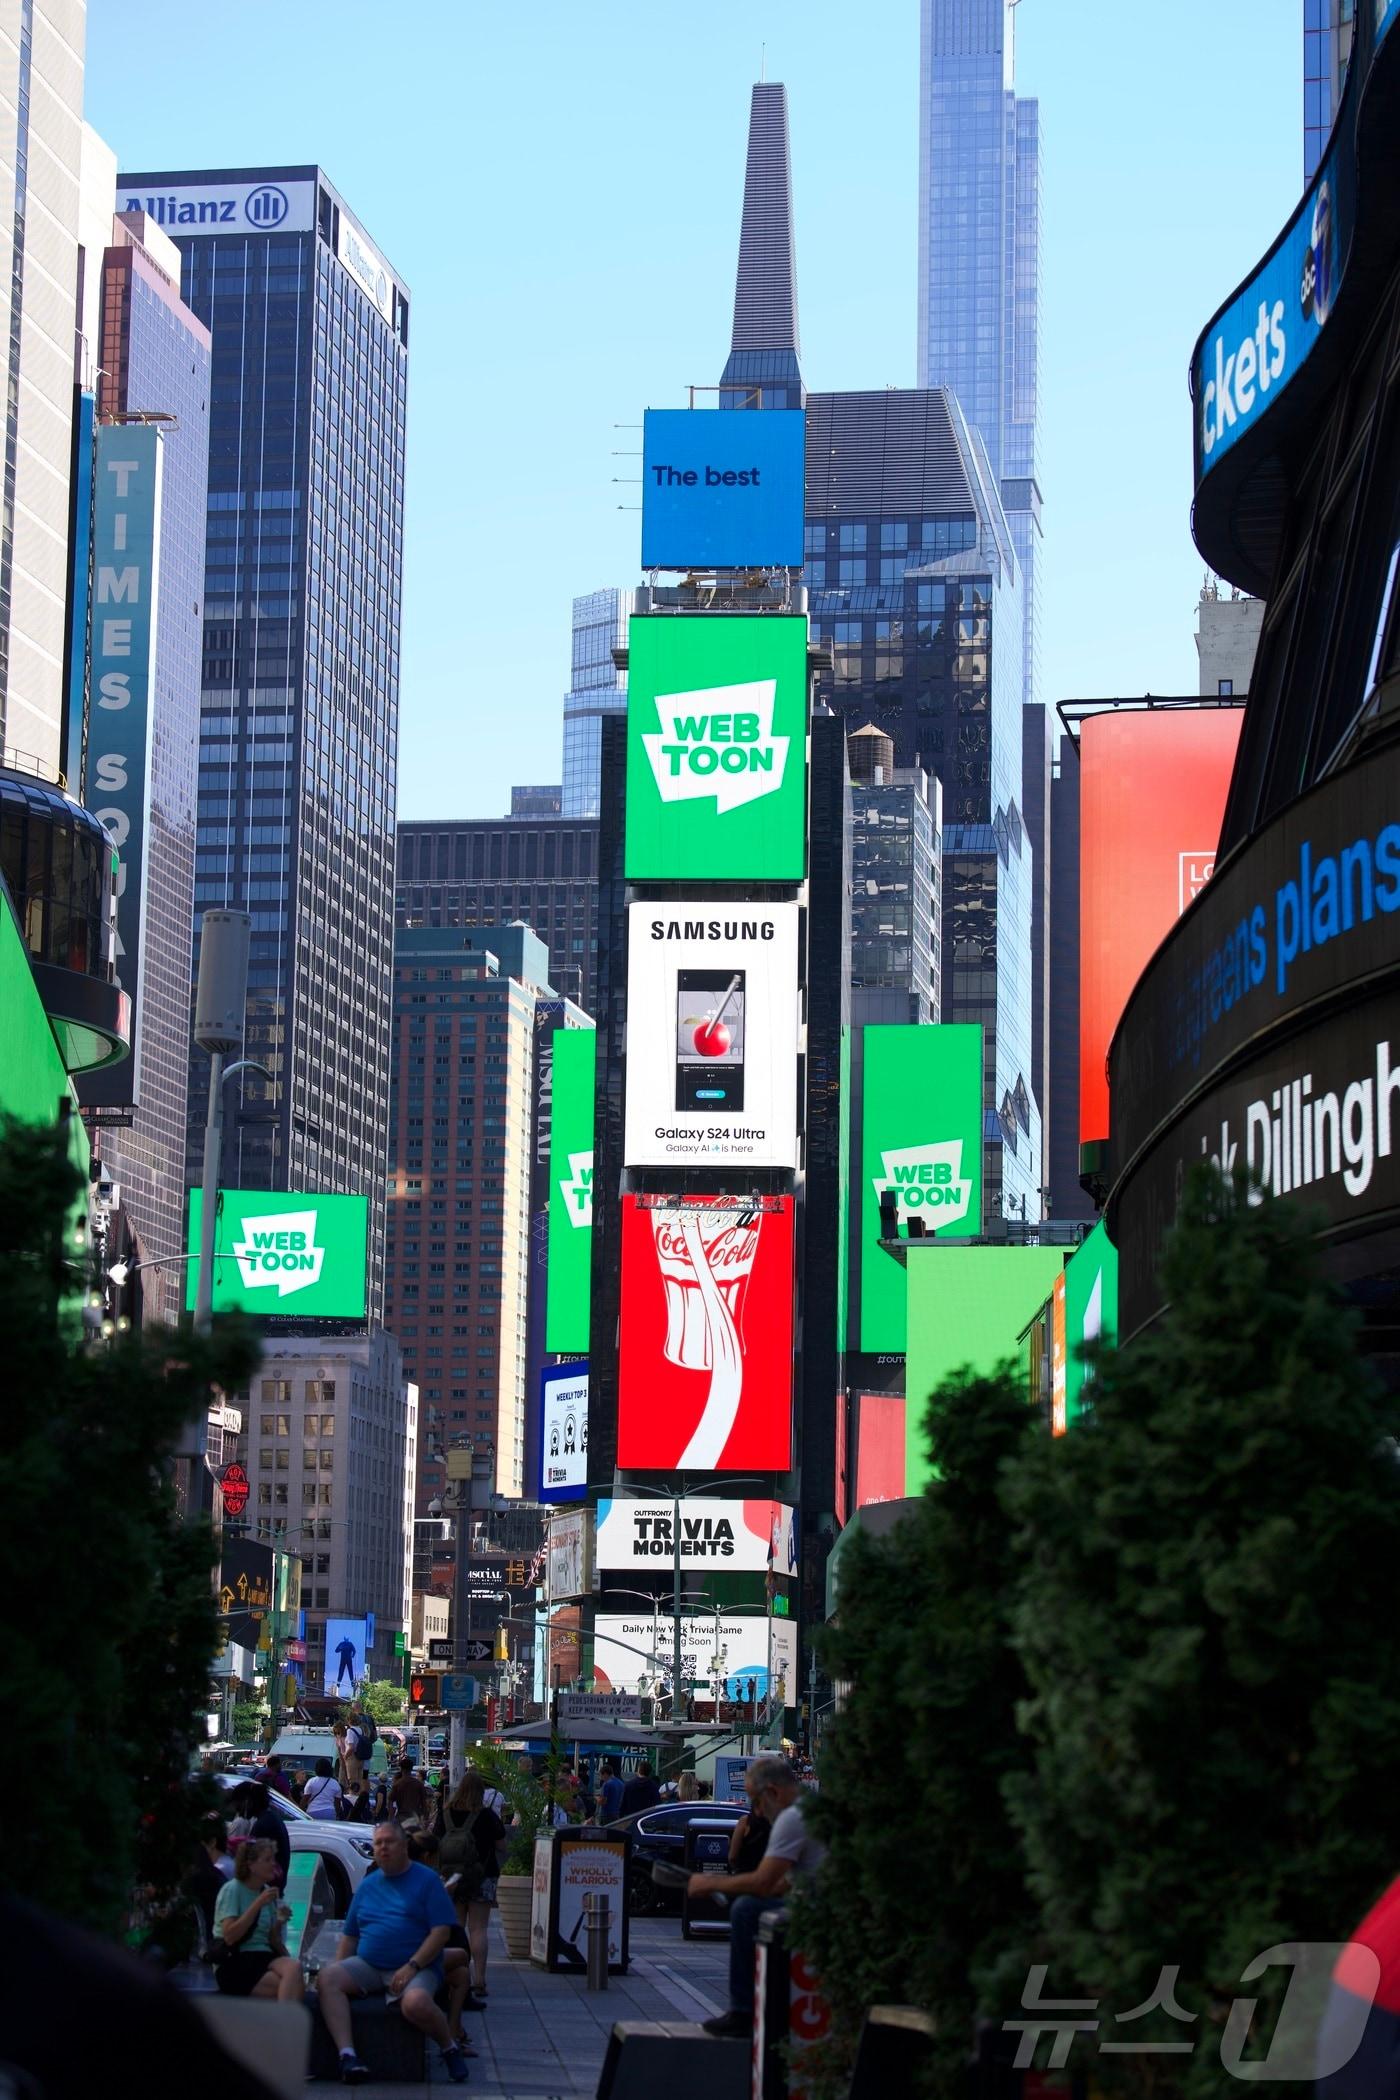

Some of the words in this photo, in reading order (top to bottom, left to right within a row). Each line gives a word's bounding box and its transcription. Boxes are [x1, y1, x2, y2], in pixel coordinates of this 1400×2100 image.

[652, 466, 699, 488] The
[704, 465, 761, 488] best
[96, 460, 140, 711] TIMES
[672, 713, 761, 743] WEB
[661, 745, 774, 777] TOON
[1276, 822, 1400, 997] plans
[651, 920, 776, 942] SAMSUNG
[654, 1127, 705, 1142] Galaxy
[707, 1127, 731, 1140] S24
[733, 1128, 765, 1140] Ultra
[665, 1143, 699, 1154] Galaxy
[721, 1143, 729, 1152] is
[731, 1143, 754, 1153] here
[893, 1163, 952, 1185] WEB
[885, 1186, 961, 1208] TOON
[252, 1231, 307, 1251] WEB
[245, 1250, 315, 1271] TOON
[556, 1392, 574, 1402] WEEKLY
[574, 1390, 584, 1400] TOP
[633, 1518, 735, 1540] TRVIA
[622, 1624, 645, 1634] Daily
[667, 1625, 688, 1634] Yk
[690, 1625, 716, 1634] Trivia
[688, 1637, 712, 1646] Soon
[568, 1696, 604, 1705] PEDESTRIAN
[605, 1697, 621, 1705] FLOW
[623, 1697, 637, 1706] ZONE
[568, 1706, 583, 1715] KEEP
[584, 1706, 607, 1715] MOVING
[565, 1876, 619, 1886] HILARIOUS
[570, 1867, 614, 1877] WHOLLY
